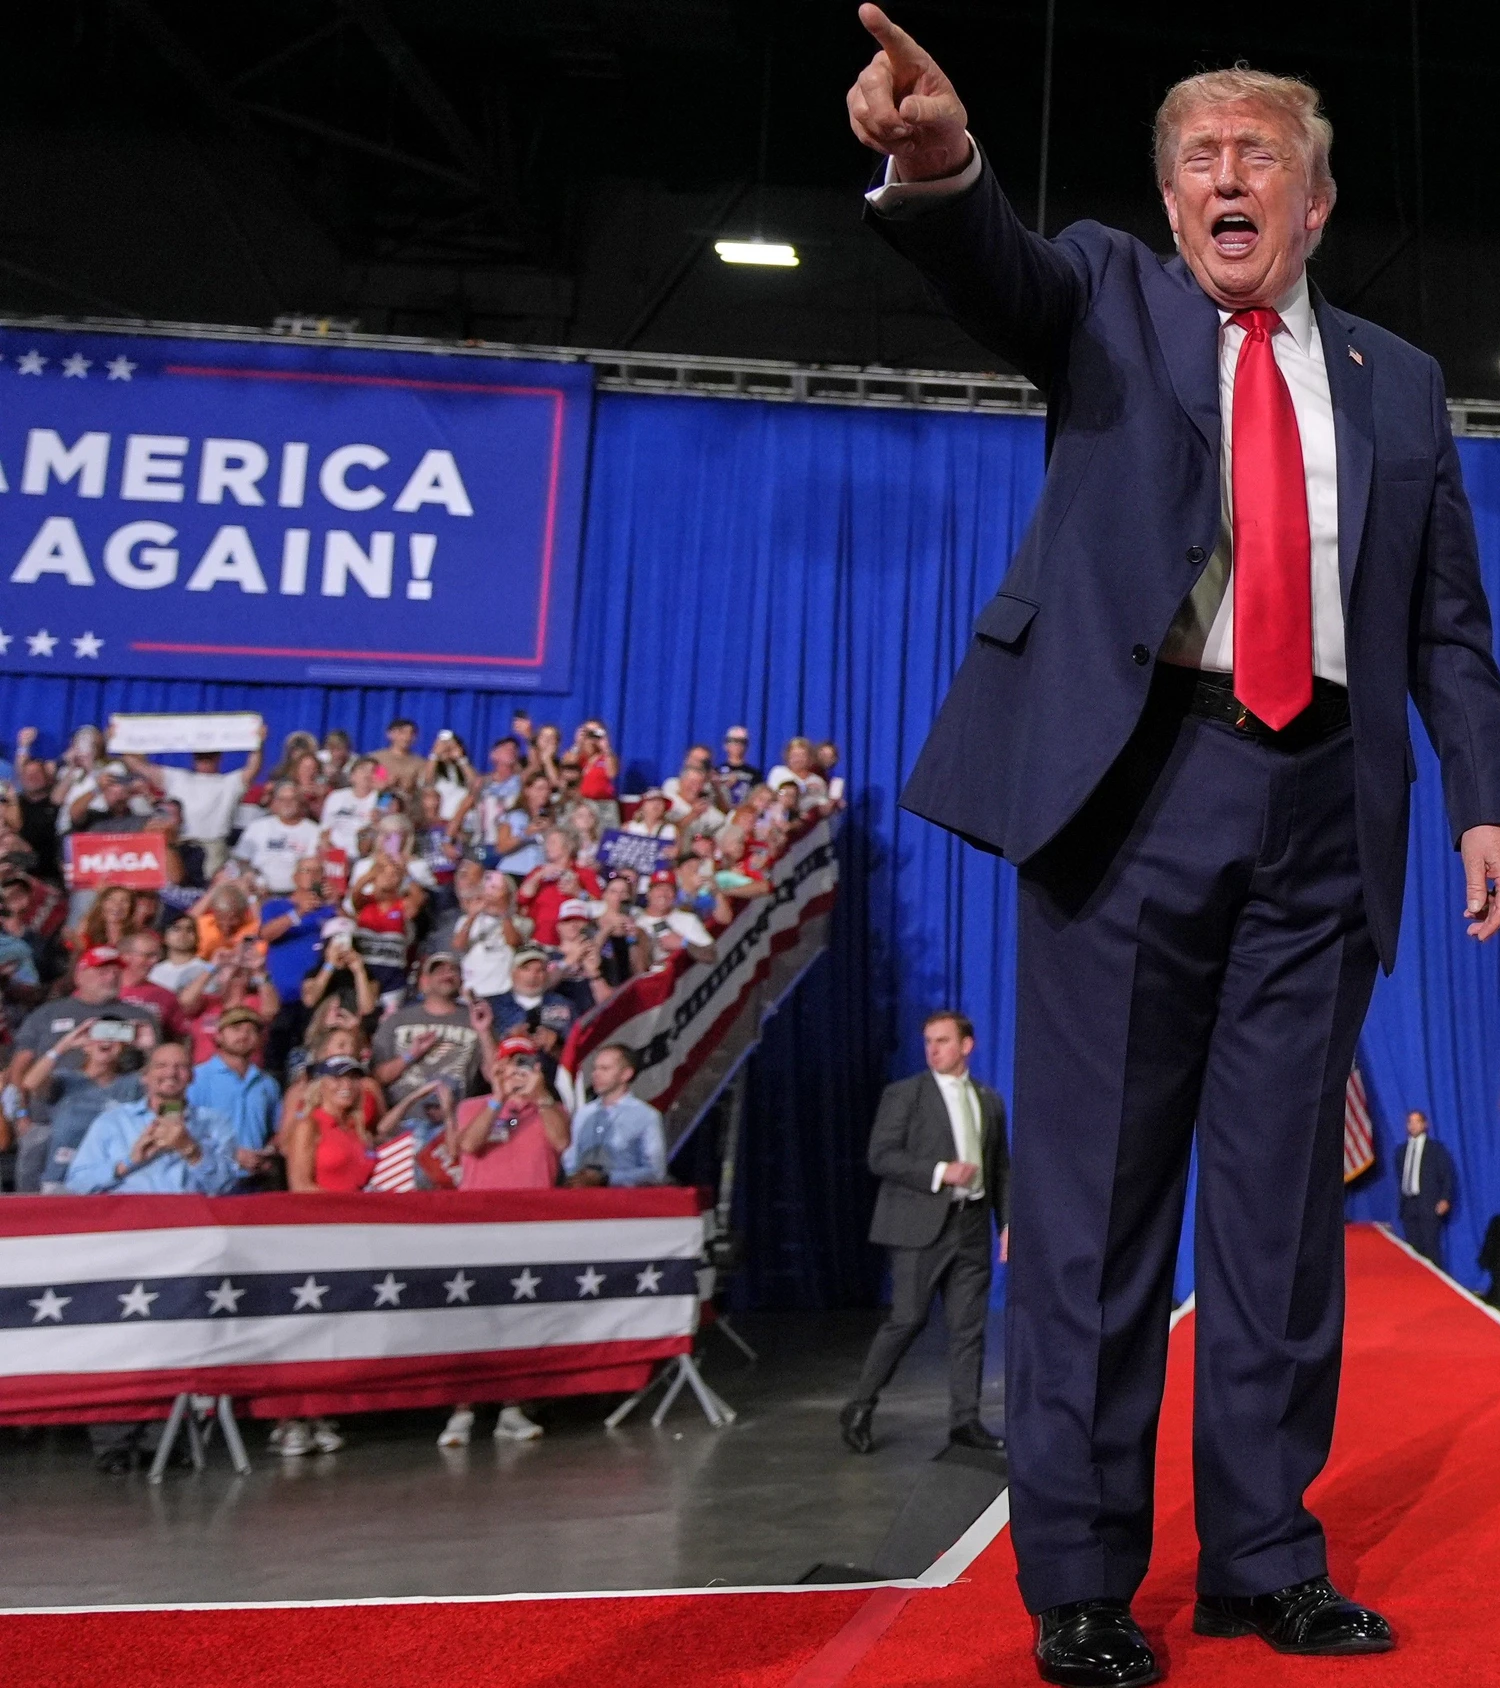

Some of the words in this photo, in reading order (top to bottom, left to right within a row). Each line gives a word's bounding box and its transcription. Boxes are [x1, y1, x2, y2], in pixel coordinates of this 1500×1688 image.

[0, 428, 473, 516] MERICA
[11, 516, 437, 600] AGAIN!
[79, 851, 159, 874] MAGA
